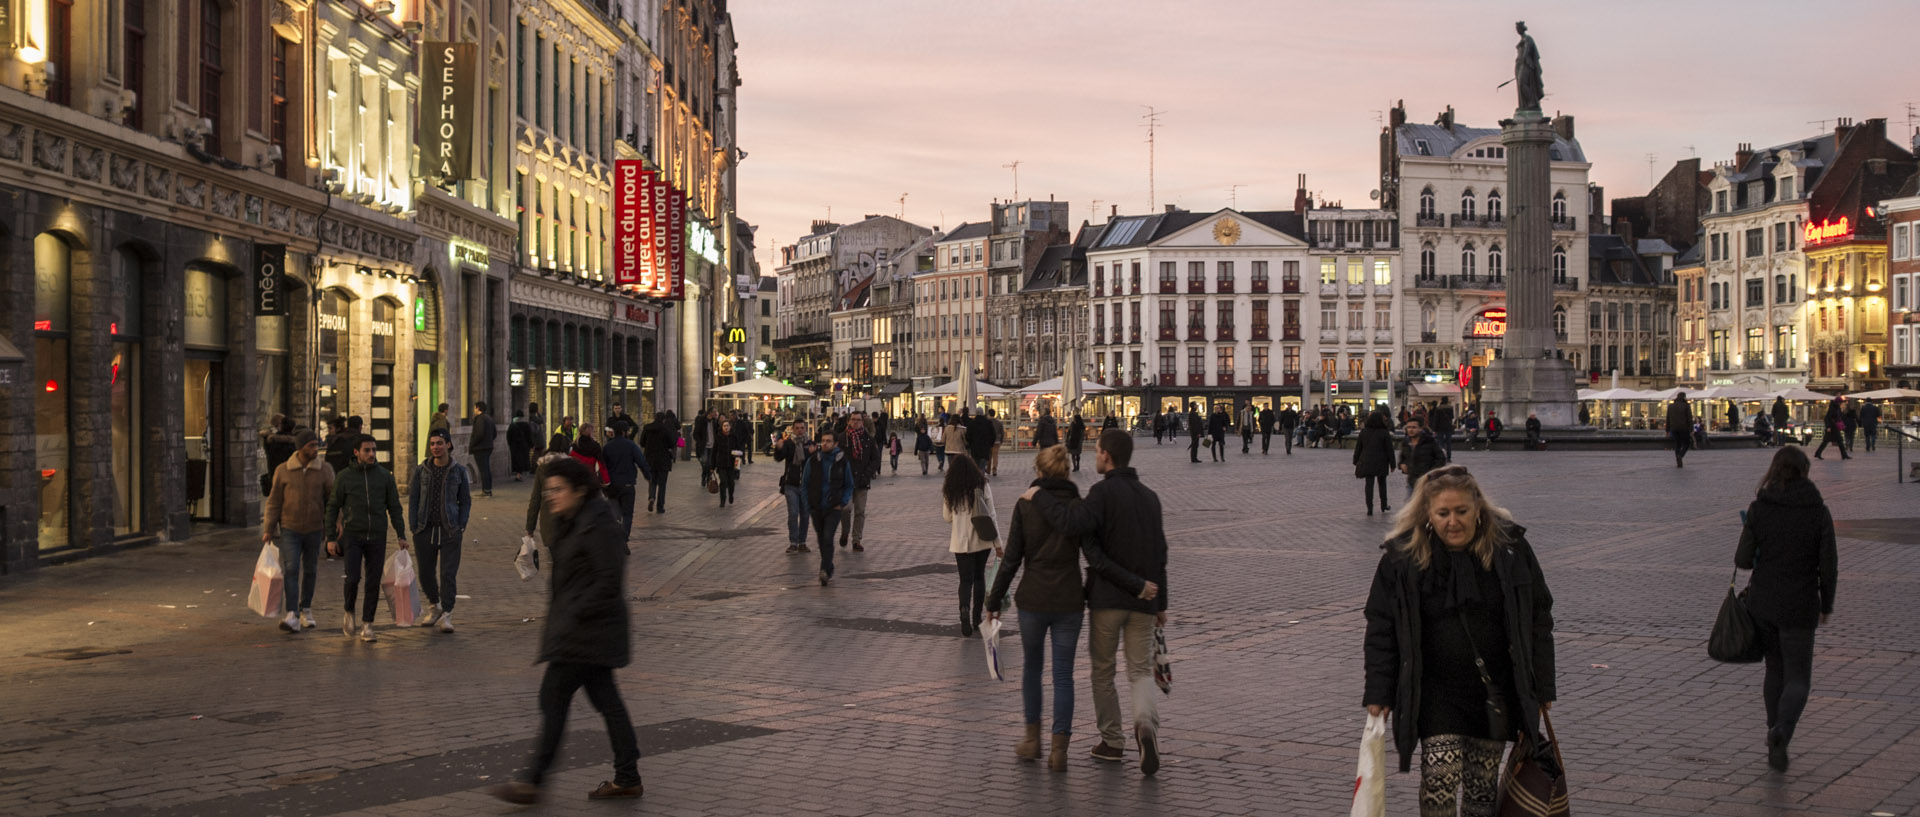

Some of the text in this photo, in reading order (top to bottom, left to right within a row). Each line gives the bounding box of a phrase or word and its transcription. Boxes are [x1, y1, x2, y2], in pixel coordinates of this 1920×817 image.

[440, 47, 455, 176] SEPHORA
[620, 164, 637, 281] Furet du nord
[654, 185, 667, 222] nord
